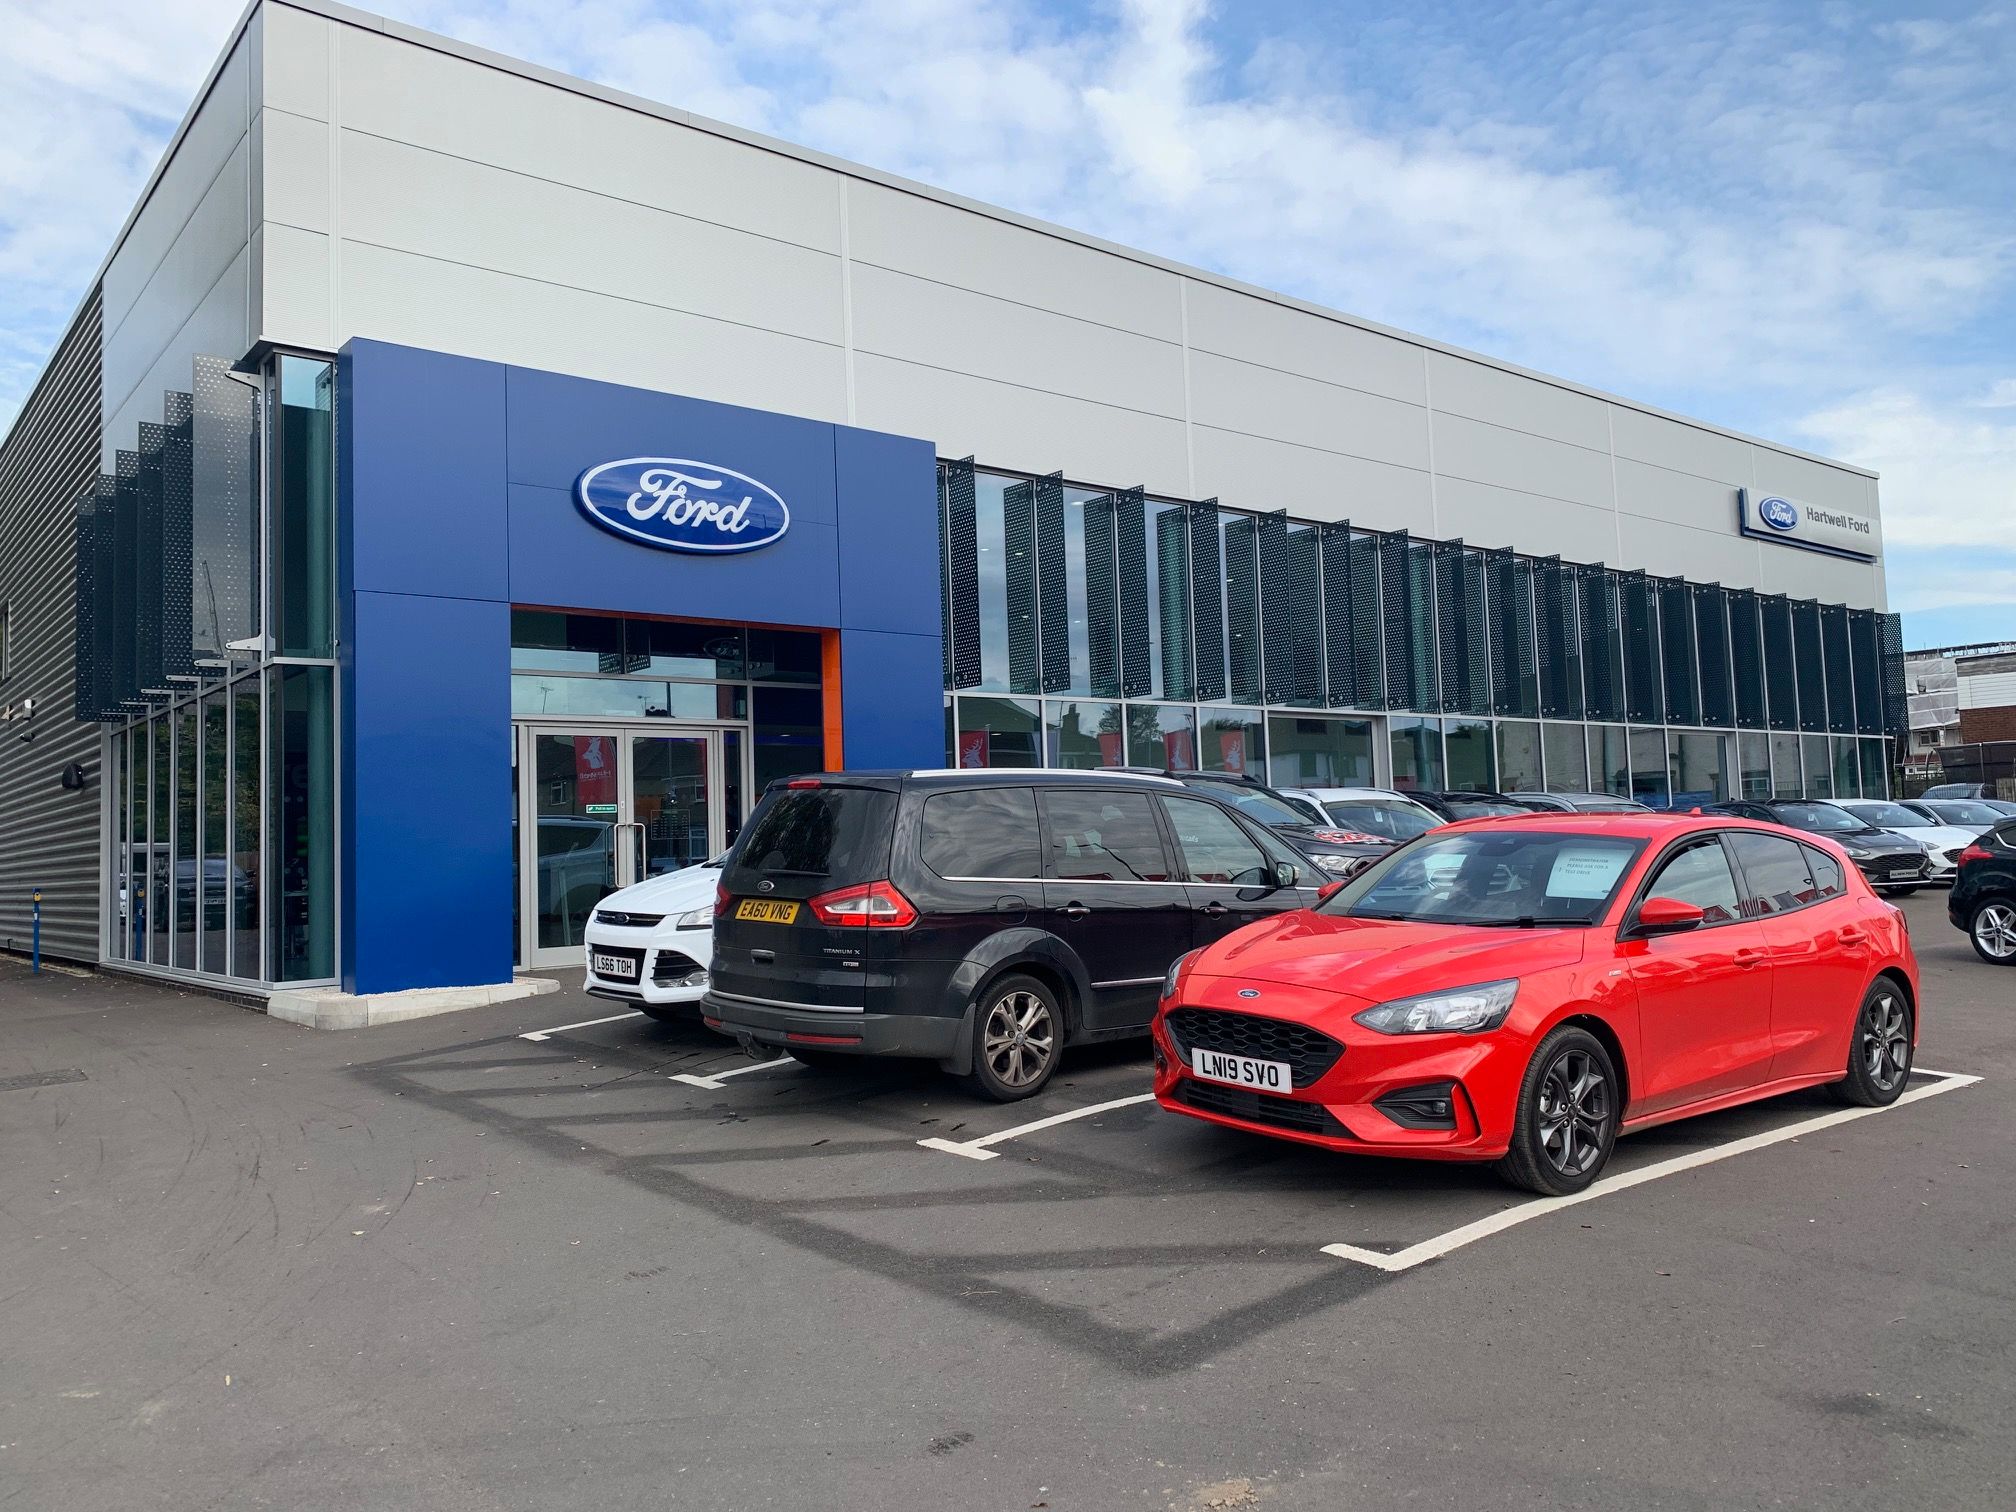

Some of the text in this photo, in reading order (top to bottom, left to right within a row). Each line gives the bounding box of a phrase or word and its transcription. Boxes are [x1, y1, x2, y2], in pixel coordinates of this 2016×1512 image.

[626, 468, 752, 534] Ford
[1770, 501, 1793, 524] Ford
[1806, 506, 1870, 534] Hartwell Ford
[740, 902, 794, 920] EA60 VNG
[616, 959, 632, 974] TOH
[1202, 1053, 1279, 1087] LN19 SVO
